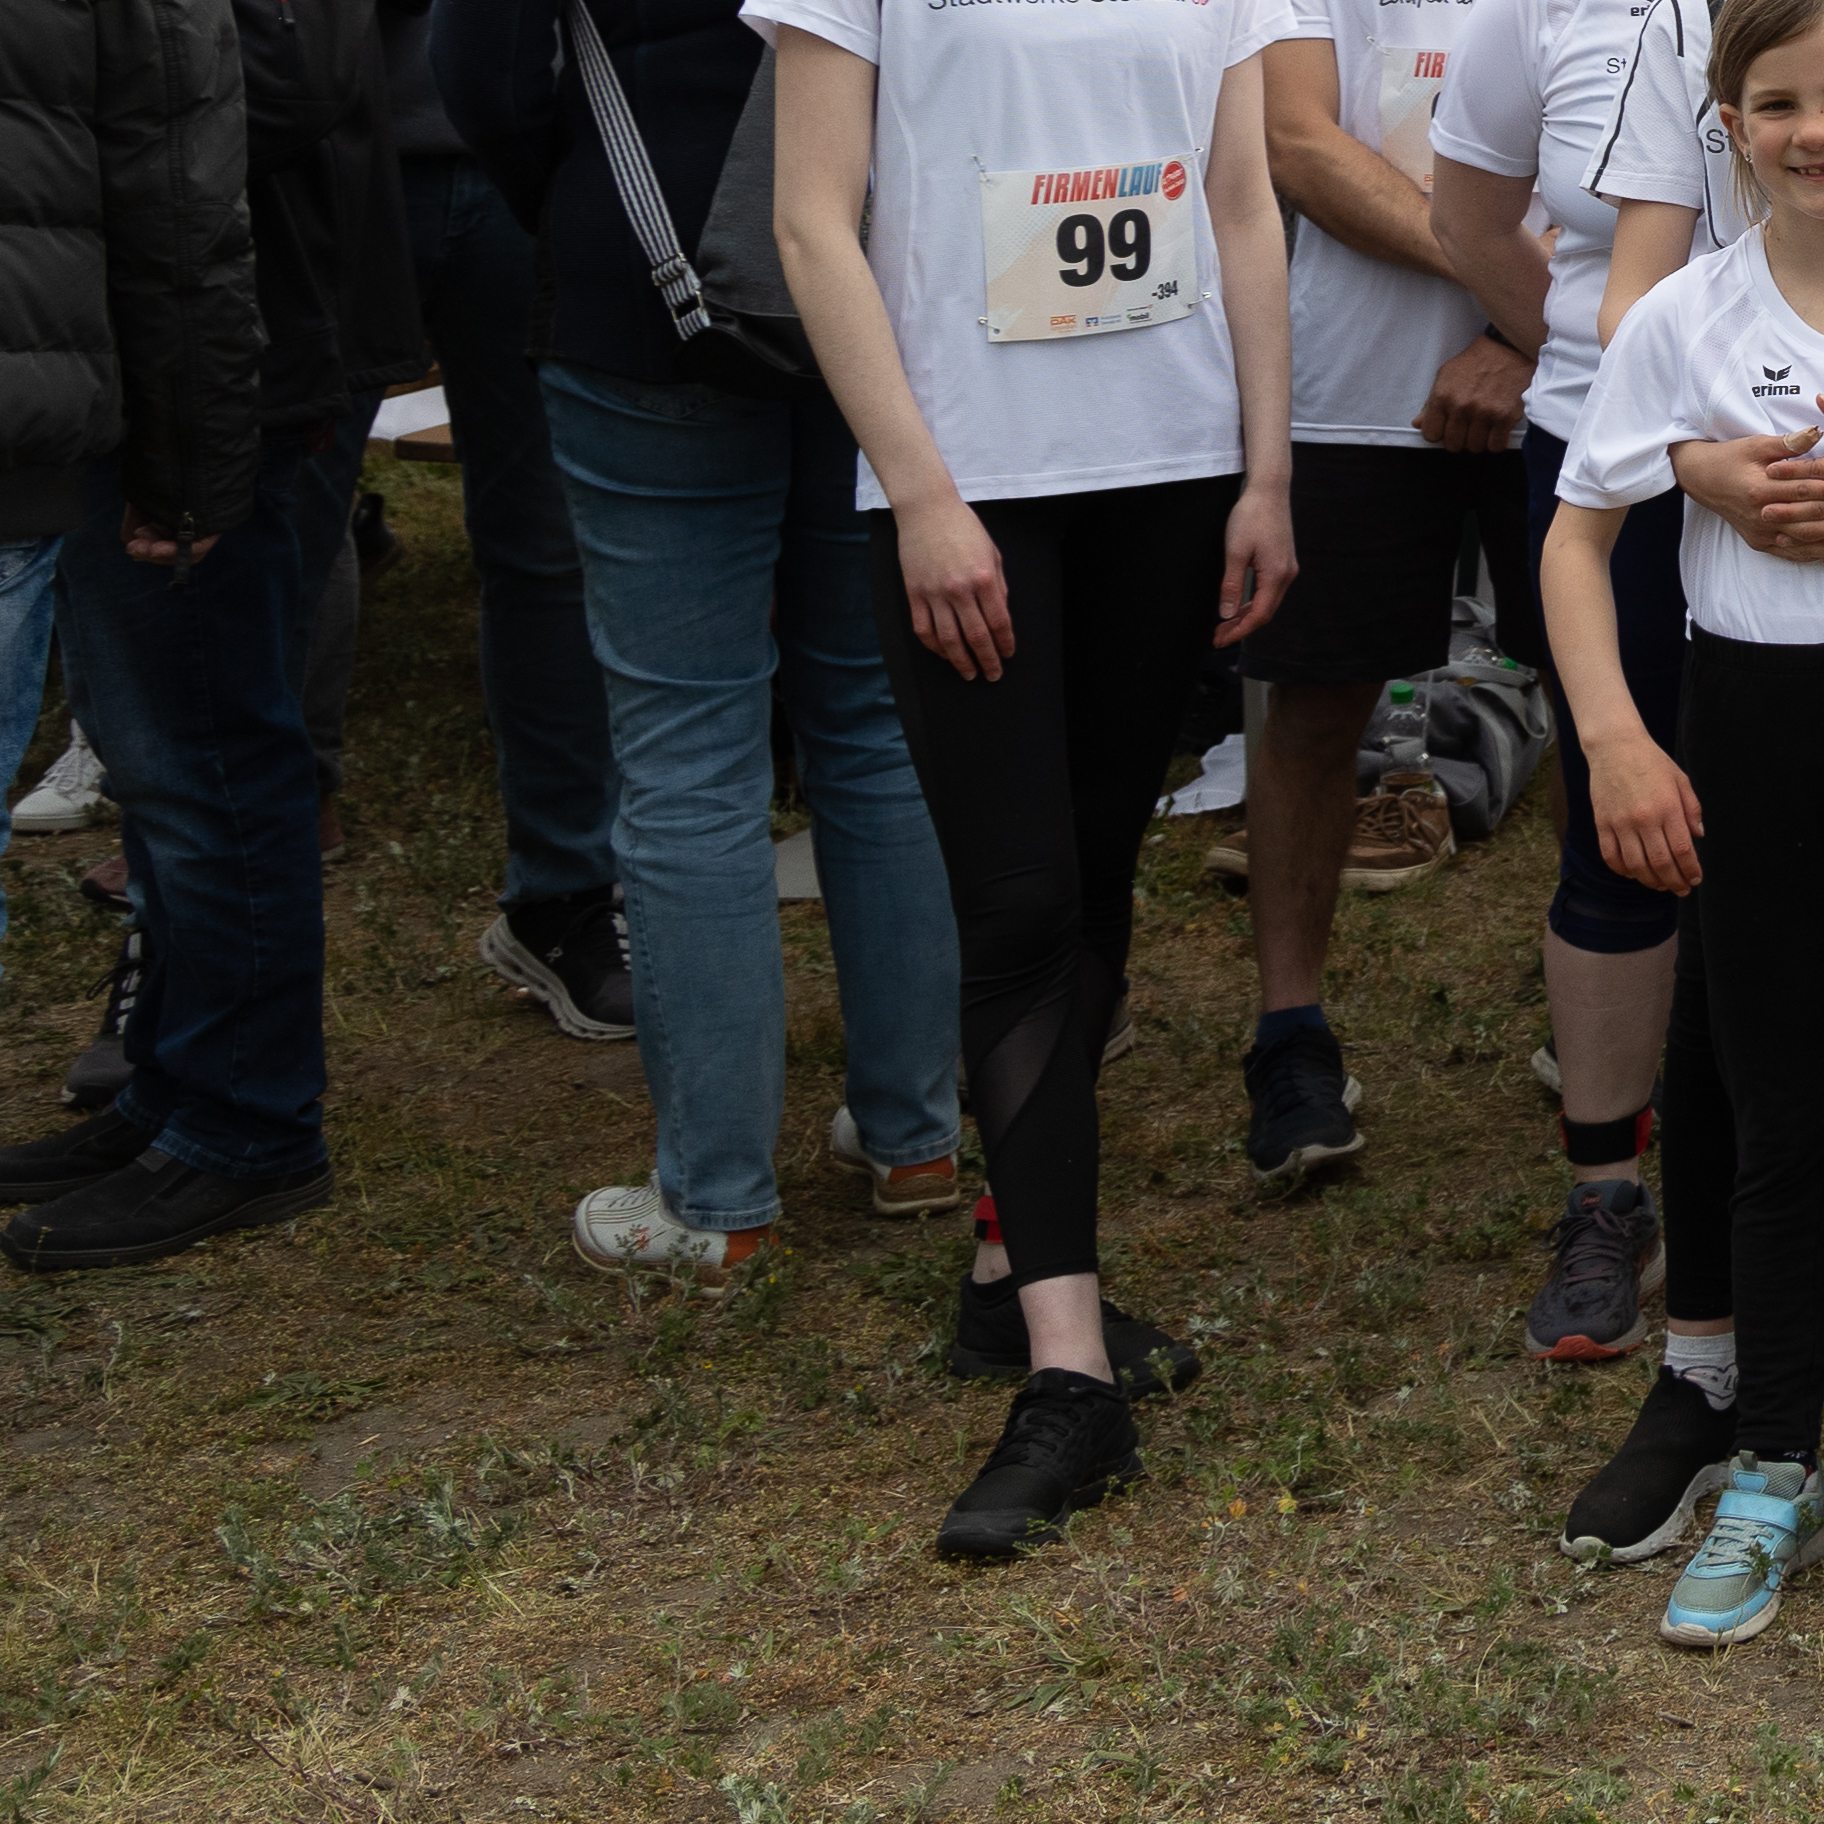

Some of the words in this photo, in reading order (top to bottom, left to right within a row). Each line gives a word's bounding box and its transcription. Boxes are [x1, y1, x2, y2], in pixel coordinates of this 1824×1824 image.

[1030, 162, 1163, 206] FIRMENLAUF
[1055, 208, 1152, 288] 99
[1151, 279, 1179, 301] -394
[1751, 383, 1801, 398] erima
